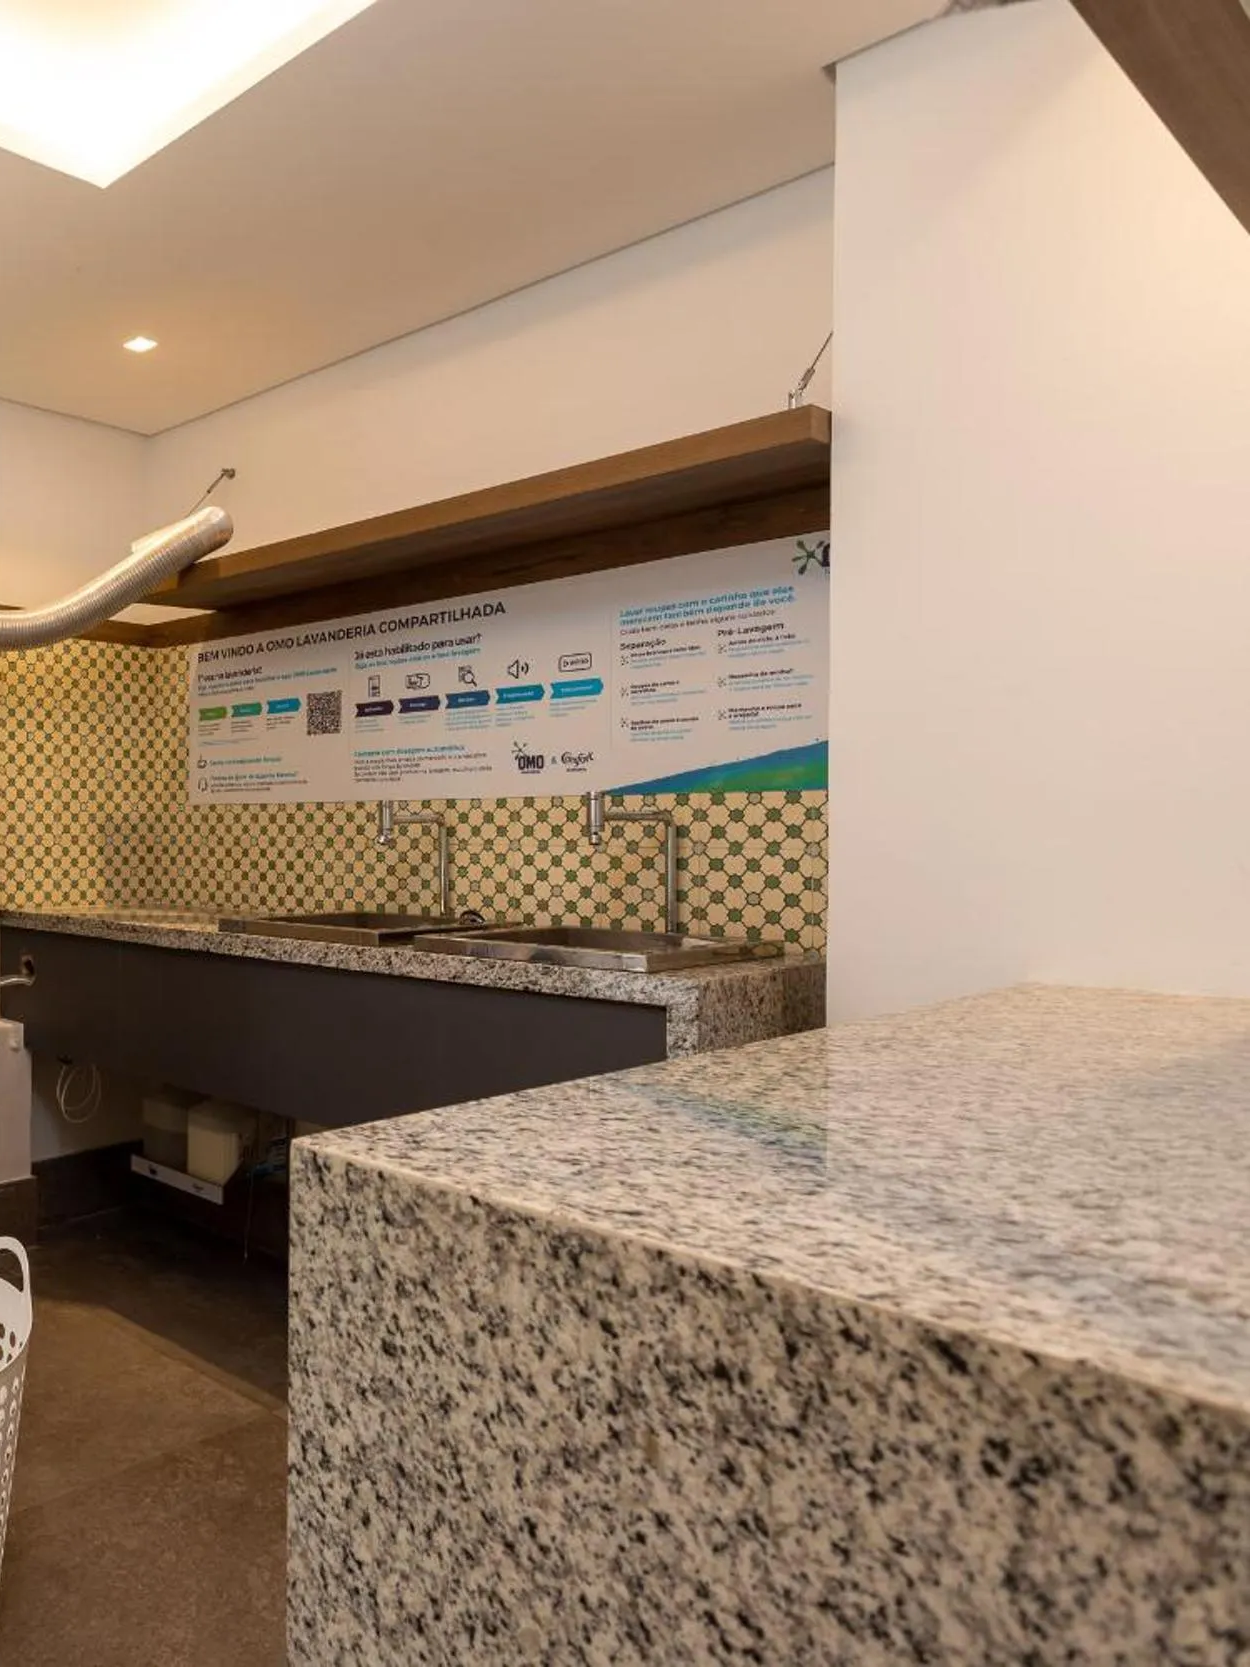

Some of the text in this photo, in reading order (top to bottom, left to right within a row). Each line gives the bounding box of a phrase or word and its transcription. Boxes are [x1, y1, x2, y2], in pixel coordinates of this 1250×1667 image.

[197, 601, 506, 663] BEM VINDO A OMO LAVANDERIA COMPARTILHADA
[385, 640, 431, 657] habilitado
[431, 637, 454, 651] para
[518, 754, 544, 770] OMO
